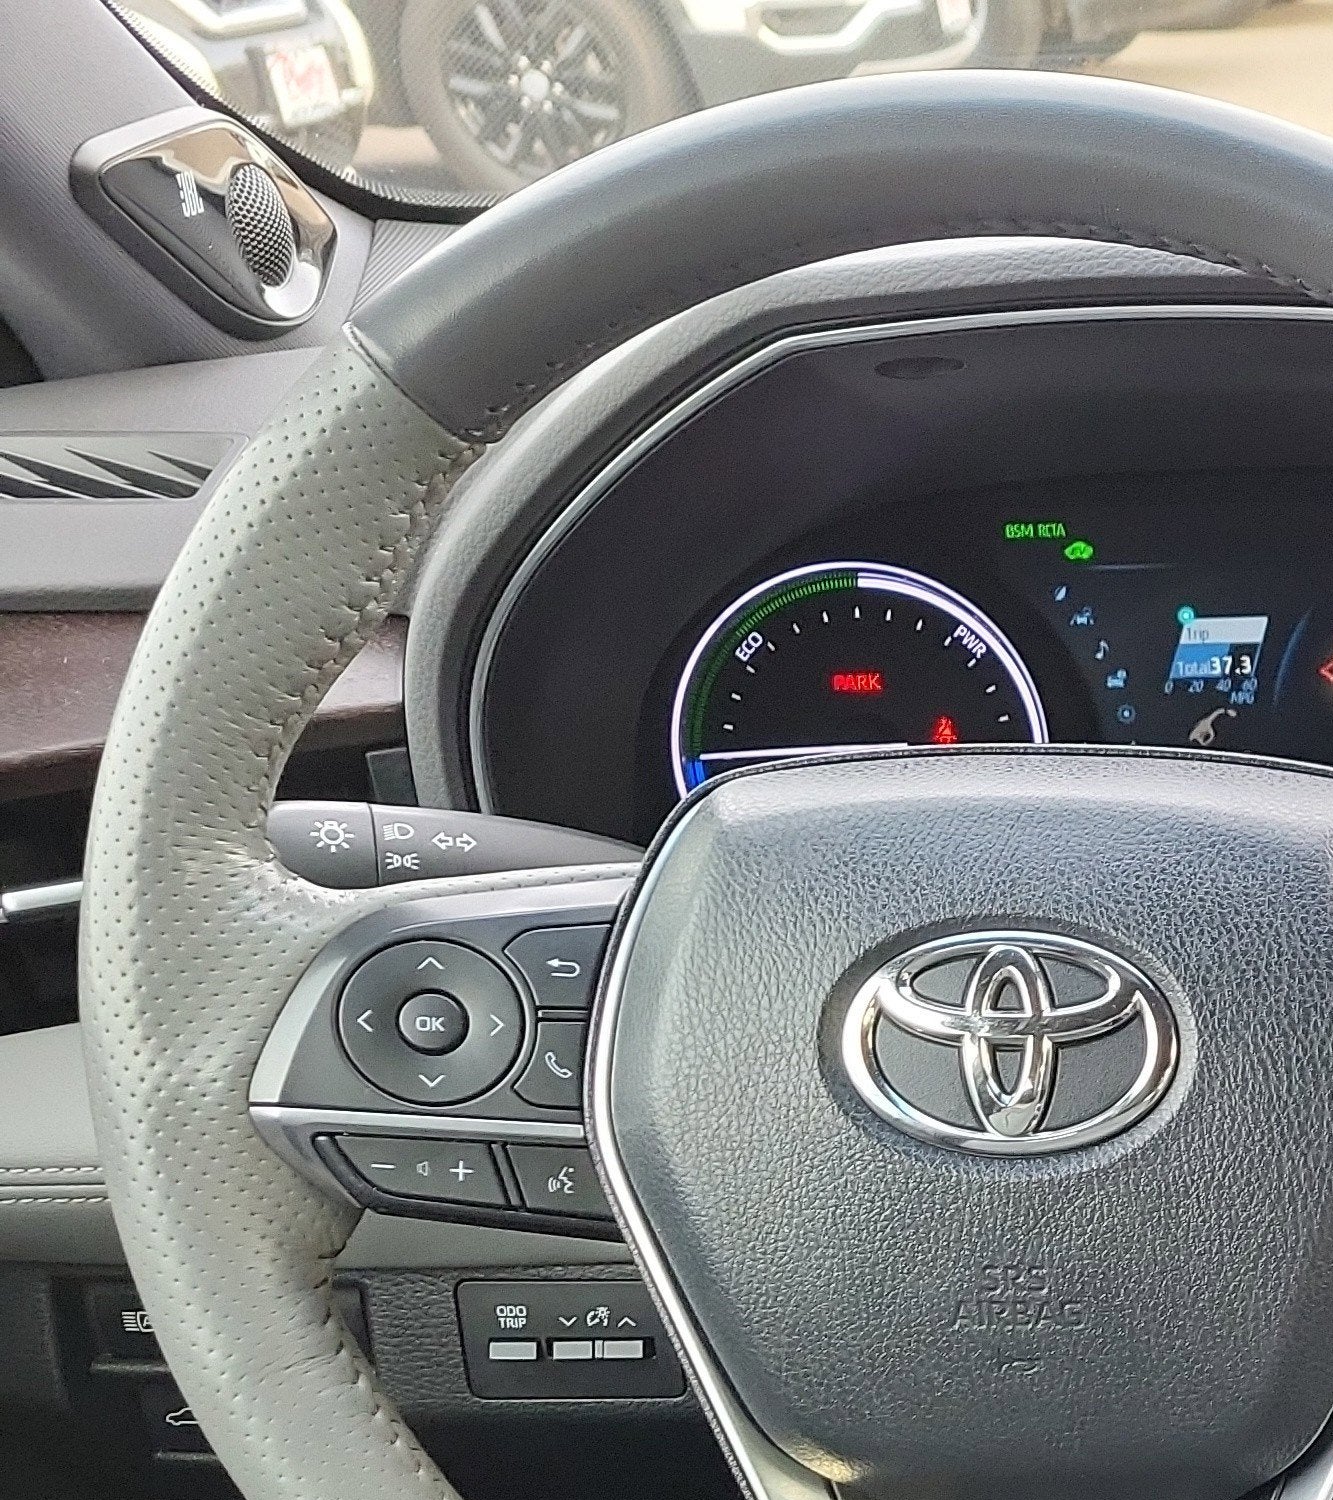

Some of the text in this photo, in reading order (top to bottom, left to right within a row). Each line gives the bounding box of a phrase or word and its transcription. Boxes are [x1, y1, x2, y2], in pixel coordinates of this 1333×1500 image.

[176, 170, 204, 217] JBL
[735, 630, 764, 663] ECO
[954, 624, 988, 660] PWR
[1209, 655, 1252, 675] 37.3
[833, 673, 881, 691] PARK
[415, 1016, 445, 1032] OK
[496, 1306, 526, 1317] ODO
[498, 1317, 527, 1328] TRIP
